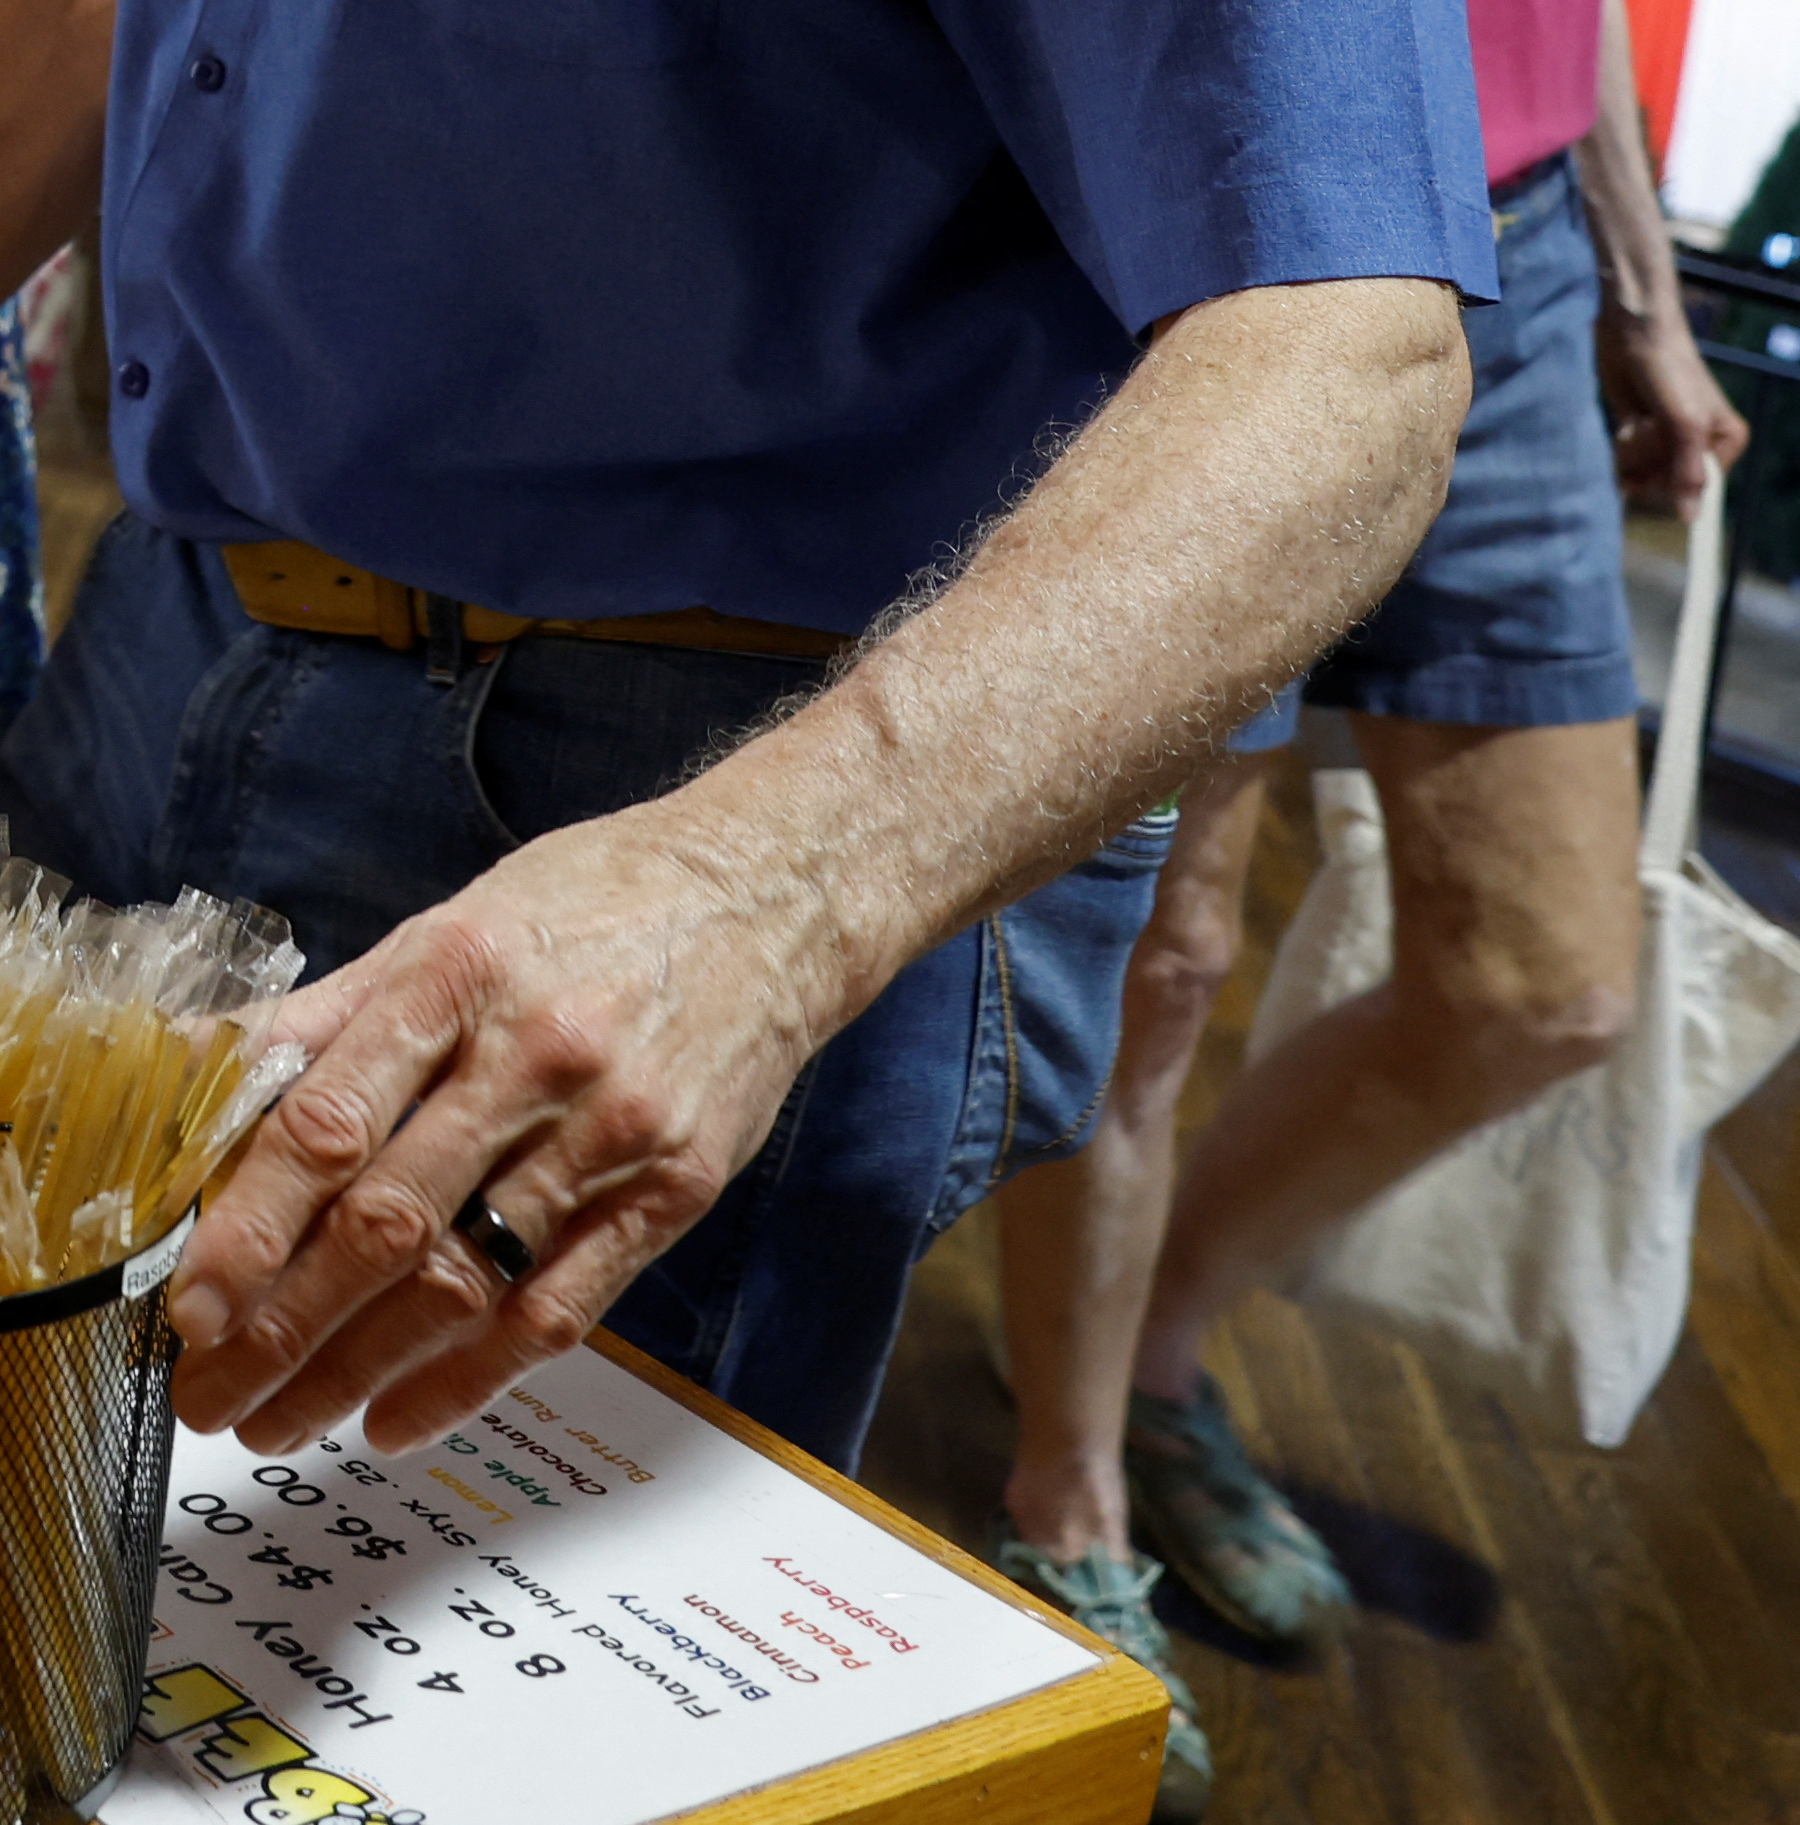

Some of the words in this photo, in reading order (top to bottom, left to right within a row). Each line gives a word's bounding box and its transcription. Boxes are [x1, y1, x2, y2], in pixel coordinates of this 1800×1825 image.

[506, 1385, 563, 1422] Rum
[480, 1412, 608, 1496] Chocolate
[484, 1459, 562, 1509] Apple
[563, 1425, 656, 1484] Butter
[251, 1464, 408, 1562] $6.00
[400, 1496, 476, 1547] Styx
[426, 1466, 515, 1524] Lemon
[178, 1492, 333, 1591] $4.00
[448, 1587, 517, 1639] oz.
[478, 1552, 576, 1619] Honey
[761, 1555, 920, 1655] Raspberry
[353, 1602, 421, 1655] oz.
[607, 1591, 771, 1702] Blackberry
[682, 1593, 820, 1684] Cinnamon
[780, 1609, 872, 1670] Peach
[234, 1618, 393, 1730] Honey
[417, 1669, 464, 1695] 4
[516, 1653, 567, 1678] 8
[571, 1621, 720, 1719] Flavored
